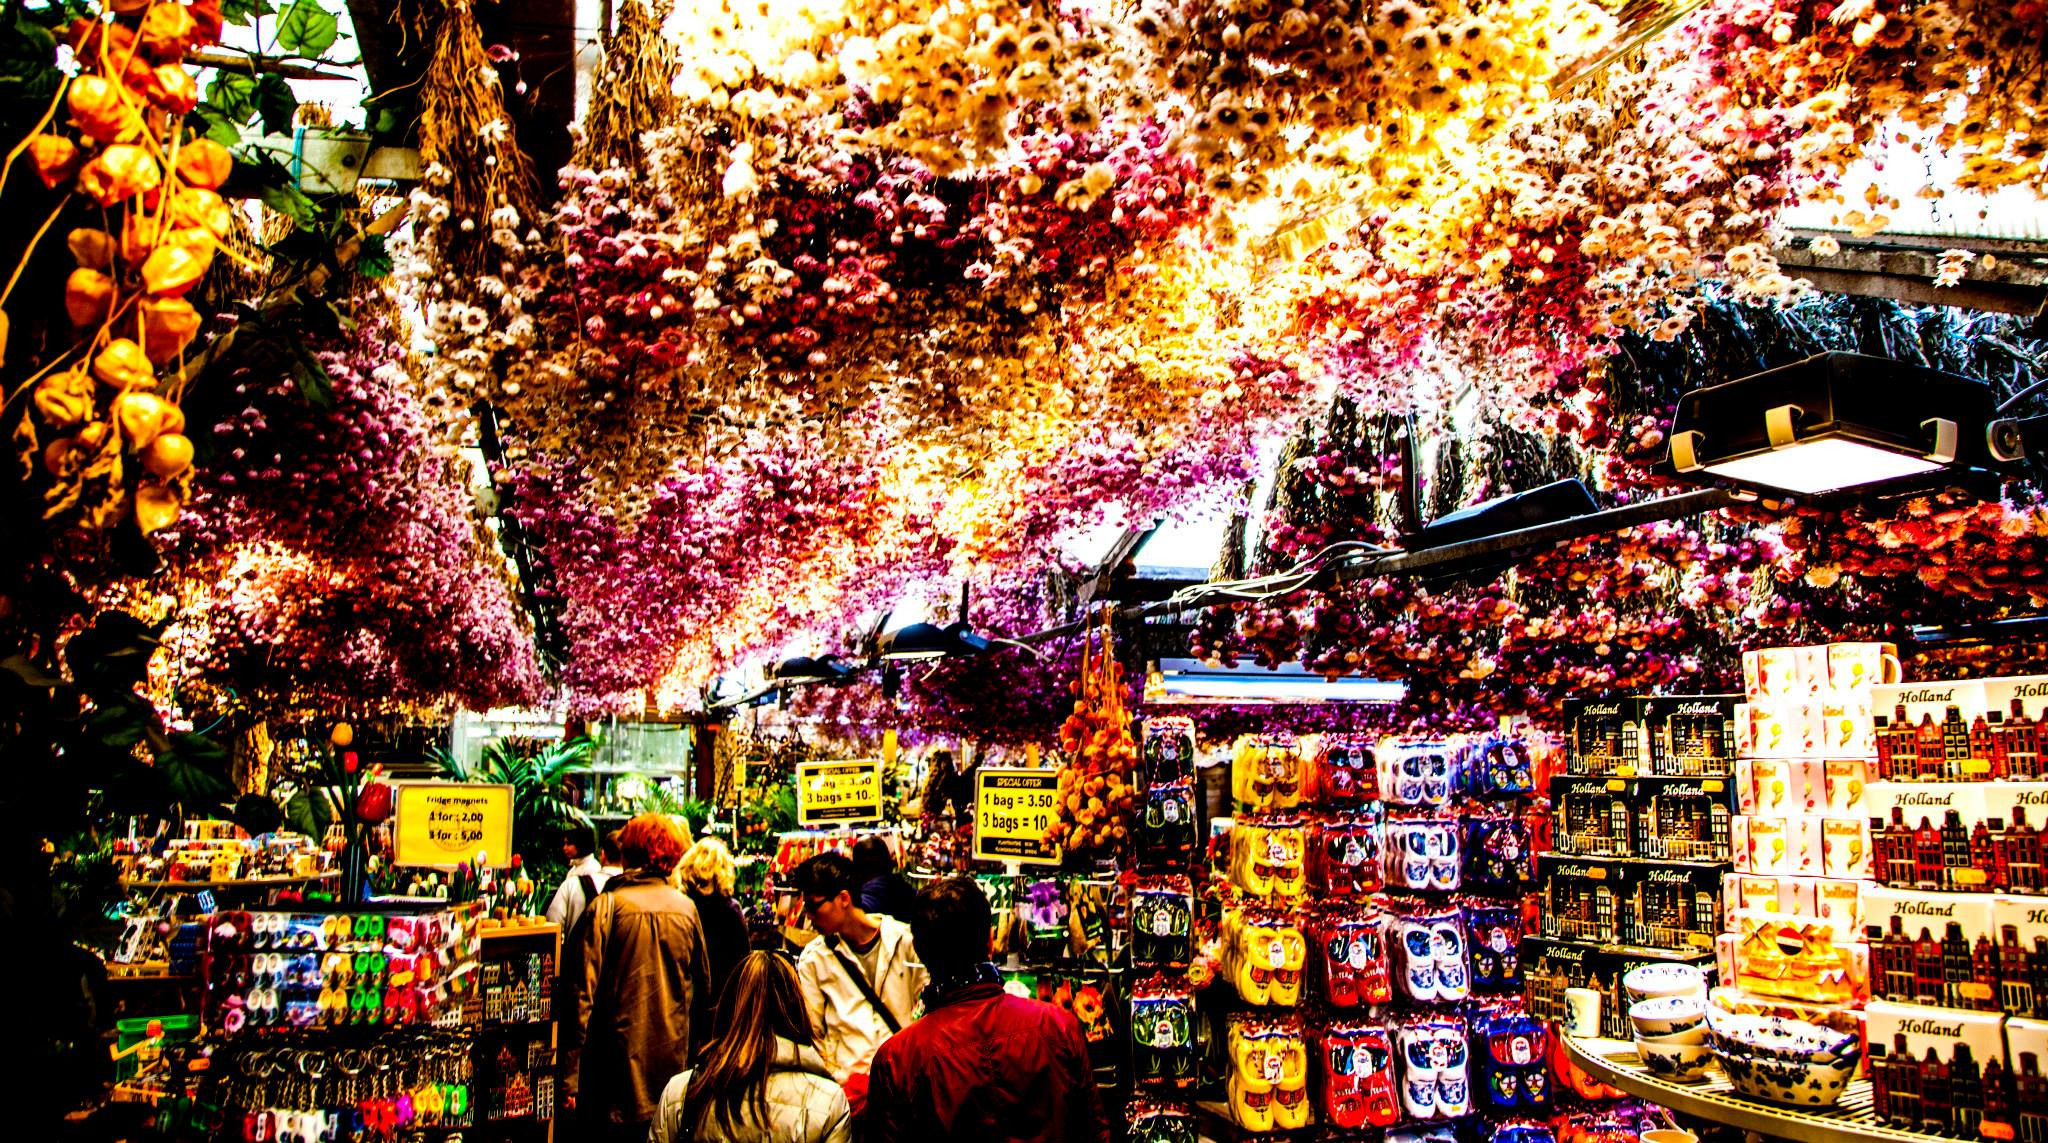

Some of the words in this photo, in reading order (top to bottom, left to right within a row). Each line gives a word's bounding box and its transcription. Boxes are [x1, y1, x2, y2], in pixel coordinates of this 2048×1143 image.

[1899, 689, 1955, 703] Holland
[1583, 703, 1621, 716] Holland
[1677, 701, 1720, 714] Holland
[997, 778, 1021, 787] SPECIAL
[1023, 778, 1042, 787] OFFER
[453, 797, 488, 807] magnets
[807, 793, 812, 803] 3
[817, 792, 841, 804] bags
[984, 793, 989, 805] 1
[993, 794, 1013, 809] bag
[1028, 794, 1053, 807] 3.50
[1895, 792, 1954, 806] Holland
[430, 811, 435, 820] 1
[438, 811, 453, 821] for
[462, 812, 484, 823] 2,00
[983, 812, 989, 827] 3
[992, 812, 1019, 833] bags
[437, 829, 452, 840] for
[1648, 870, 1692, 883] Holland
[1894, 902, 1956, 917] Holland
[1546, 947, 1585, 961] Holland
[1898, 1019, 1965, 1037] Holland
